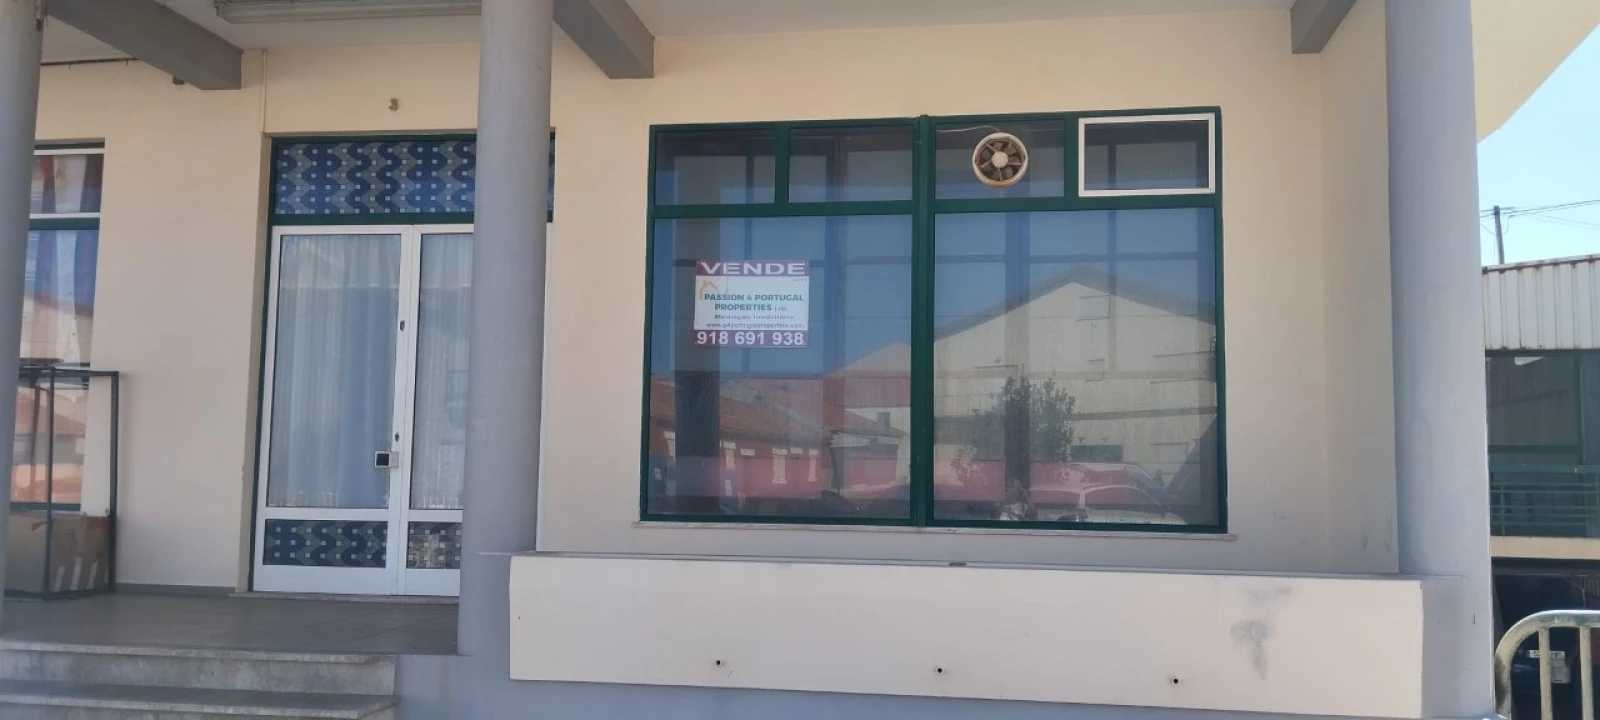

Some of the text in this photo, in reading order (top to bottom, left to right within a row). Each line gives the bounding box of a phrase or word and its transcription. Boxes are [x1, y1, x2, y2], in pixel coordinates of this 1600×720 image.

[700, 262, 806, 275] VENDE
[704, 293, 745, 301] PASSION
[714, 303, 772, 311] PROPERTIES
[697, 331, 804, 346] 918 691 938
